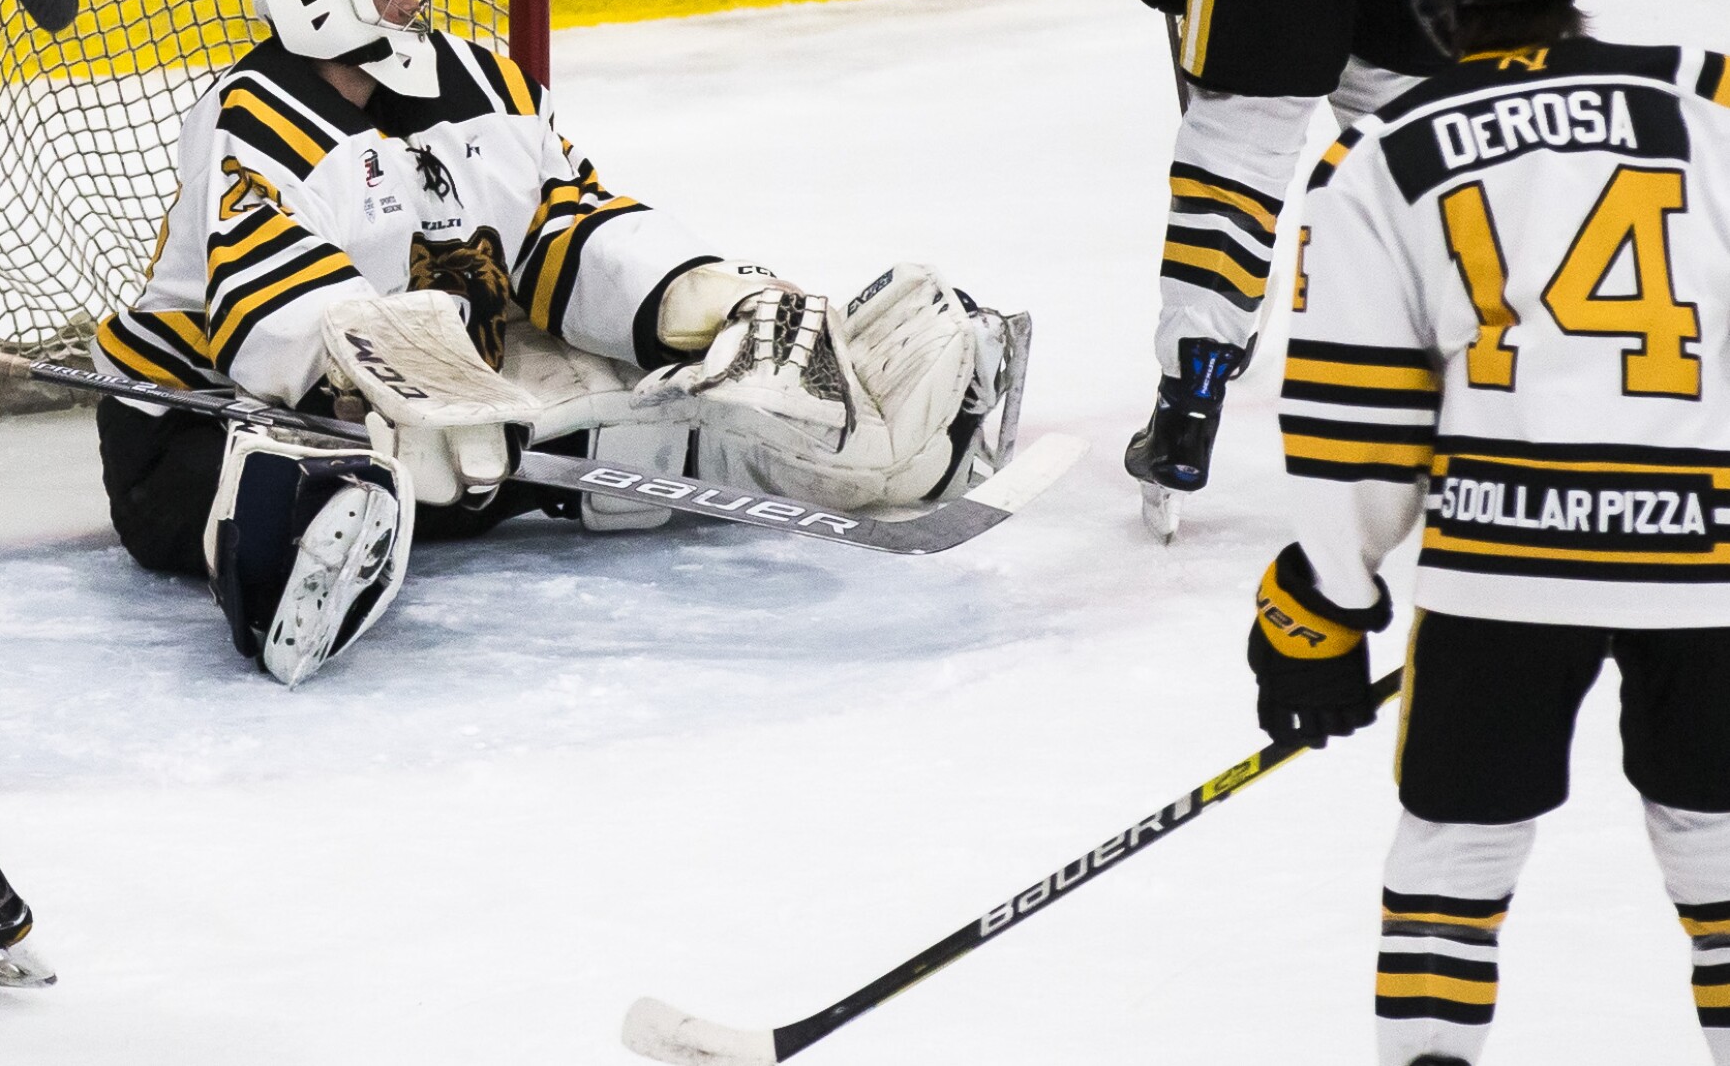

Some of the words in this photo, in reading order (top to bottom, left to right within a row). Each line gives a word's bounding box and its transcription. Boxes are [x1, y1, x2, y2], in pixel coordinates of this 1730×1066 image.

[738, 265, 777, 279] CC
[1438, 163, 1702, 401] 14
[579, 467, 861, 536] BAUER
[1599, 491, 1706, 534] PIZZA
[980, 810, 1165, 938] BAUER
